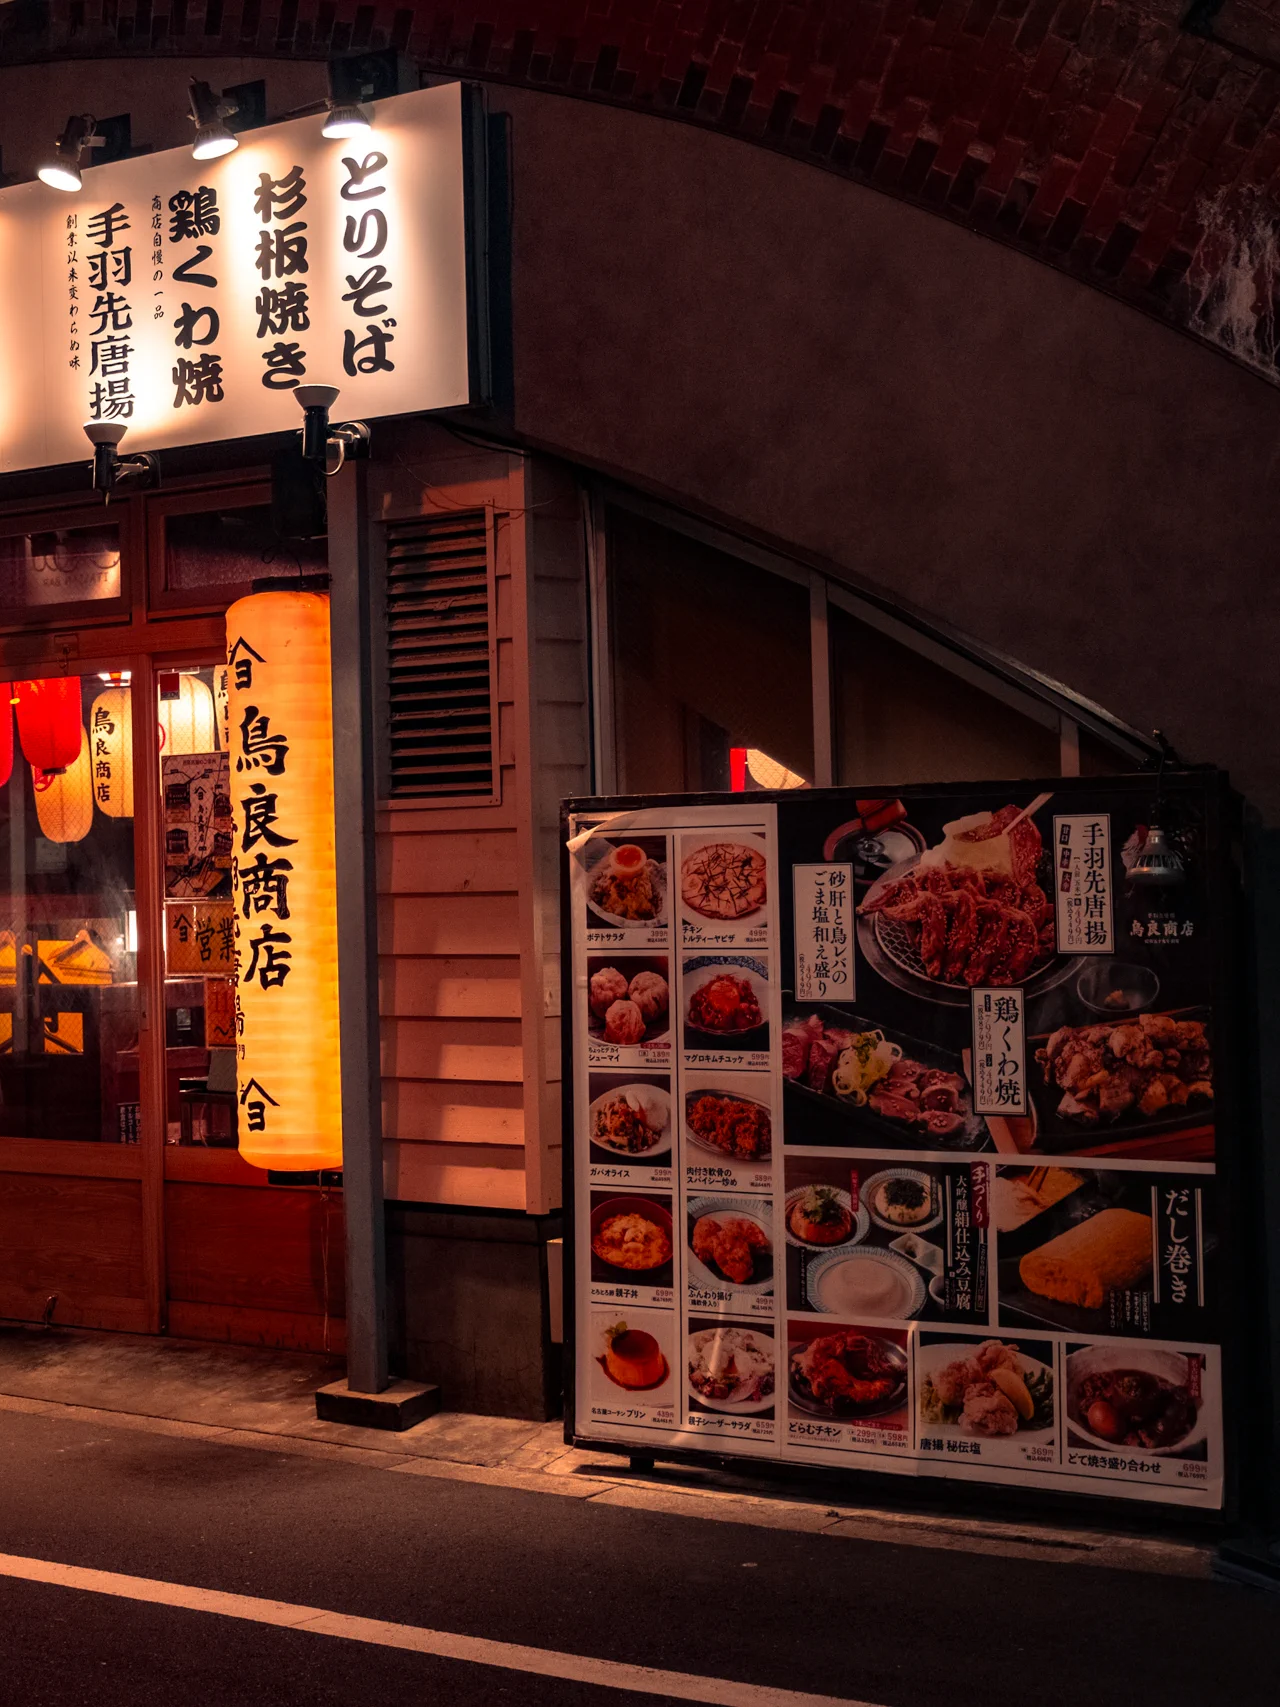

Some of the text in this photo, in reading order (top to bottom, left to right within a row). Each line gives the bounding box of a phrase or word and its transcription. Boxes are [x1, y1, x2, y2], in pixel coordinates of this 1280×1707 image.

[66, 214, 81, 371] 創業以来変わらぬ味
[86, 202, 135, 420] 手羽先唐揚
[151, 195, 165, 320] 商店自慢の一品
[169, 186, 224, 408] 鶏くわ焼
[254, 165, 310, 390] 杉板焼き
[340, 151, 397, 377] とりそば
[93, 706, 115, 803] 鳥良商店
[236, 706, 299, 990] 鳥良商店
[1082, 822, 1108, 945] 手羽先唐揚
[587, 932, 625, 942] ポテトサラダ
[682, 926, 703, 934] チキン
[812, 870, 831, 998] ごま塩和え盛り
[828, 870, 847, 985] 砂肝と鳥レバの
[1130, 919, 1195, 938] 鳥良商店
[588, 1054, 621, 1062] シューマイ
[993, 996, 1022, 1106] 鶏くわ焼
[954, 1175, 972, 1311] 大吟醸絹仕込み豆腐
[971, 1164, 986, 1224] 手づくり
[1164, 1189, 1192, 1304] だし巻き
[615, 1288, 638, 1299] 親子丼
[688, 1290, 733, 1301] ふんわり揚げ
[627, 1409, 646, 1418] プリン
[688, 1416, 751, 1431] 親子シーザーサラダ
[789, 1422, 842, 1437] どらむチキン
[1068, 1453, 1161, 1474] どて焼き盛り合わせ
